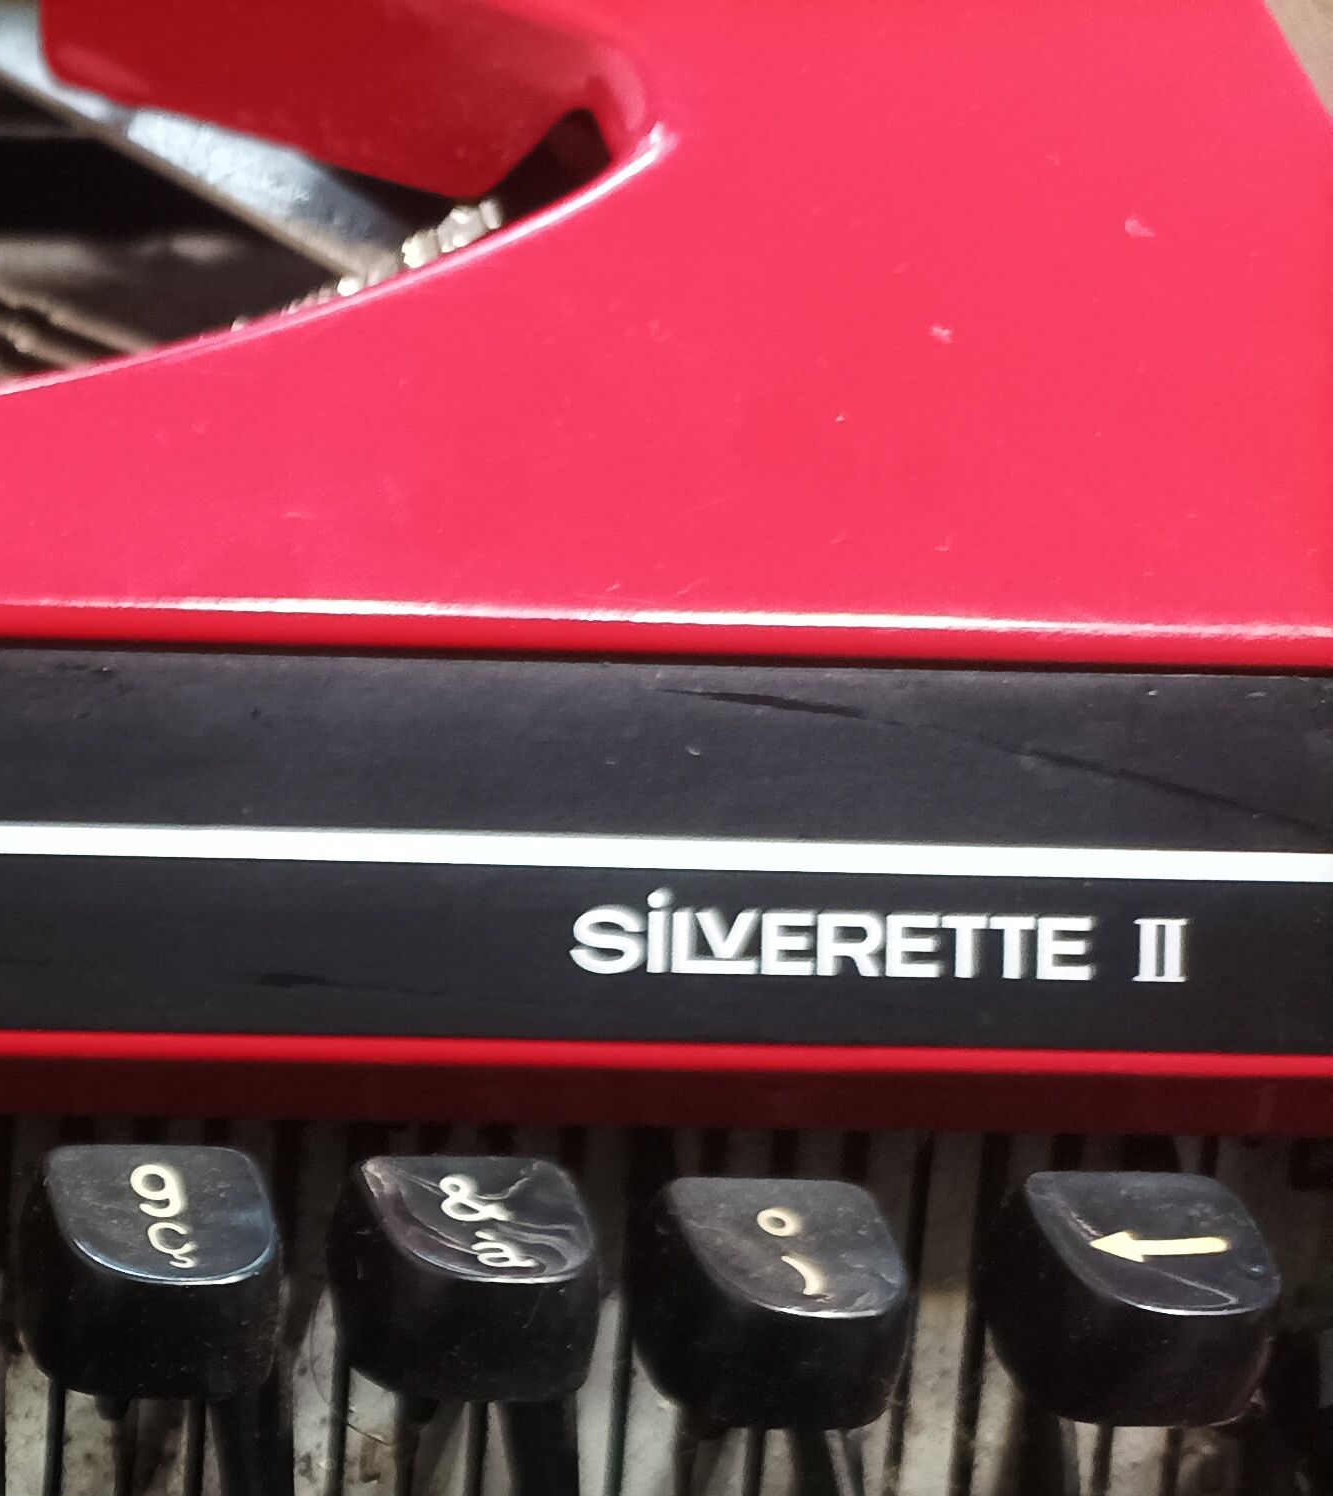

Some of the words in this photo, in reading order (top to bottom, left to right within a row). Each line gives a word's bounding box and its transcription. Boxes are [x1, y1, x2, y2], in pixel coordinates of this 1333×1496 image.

[1132, 918, 1188, 983] II
[130, 1163, 186, 1218] 9
[438, 1174, 509, 1222] &
[147, 1221, 197, 1269] ç
[471, 1230, 537, 1269] à
